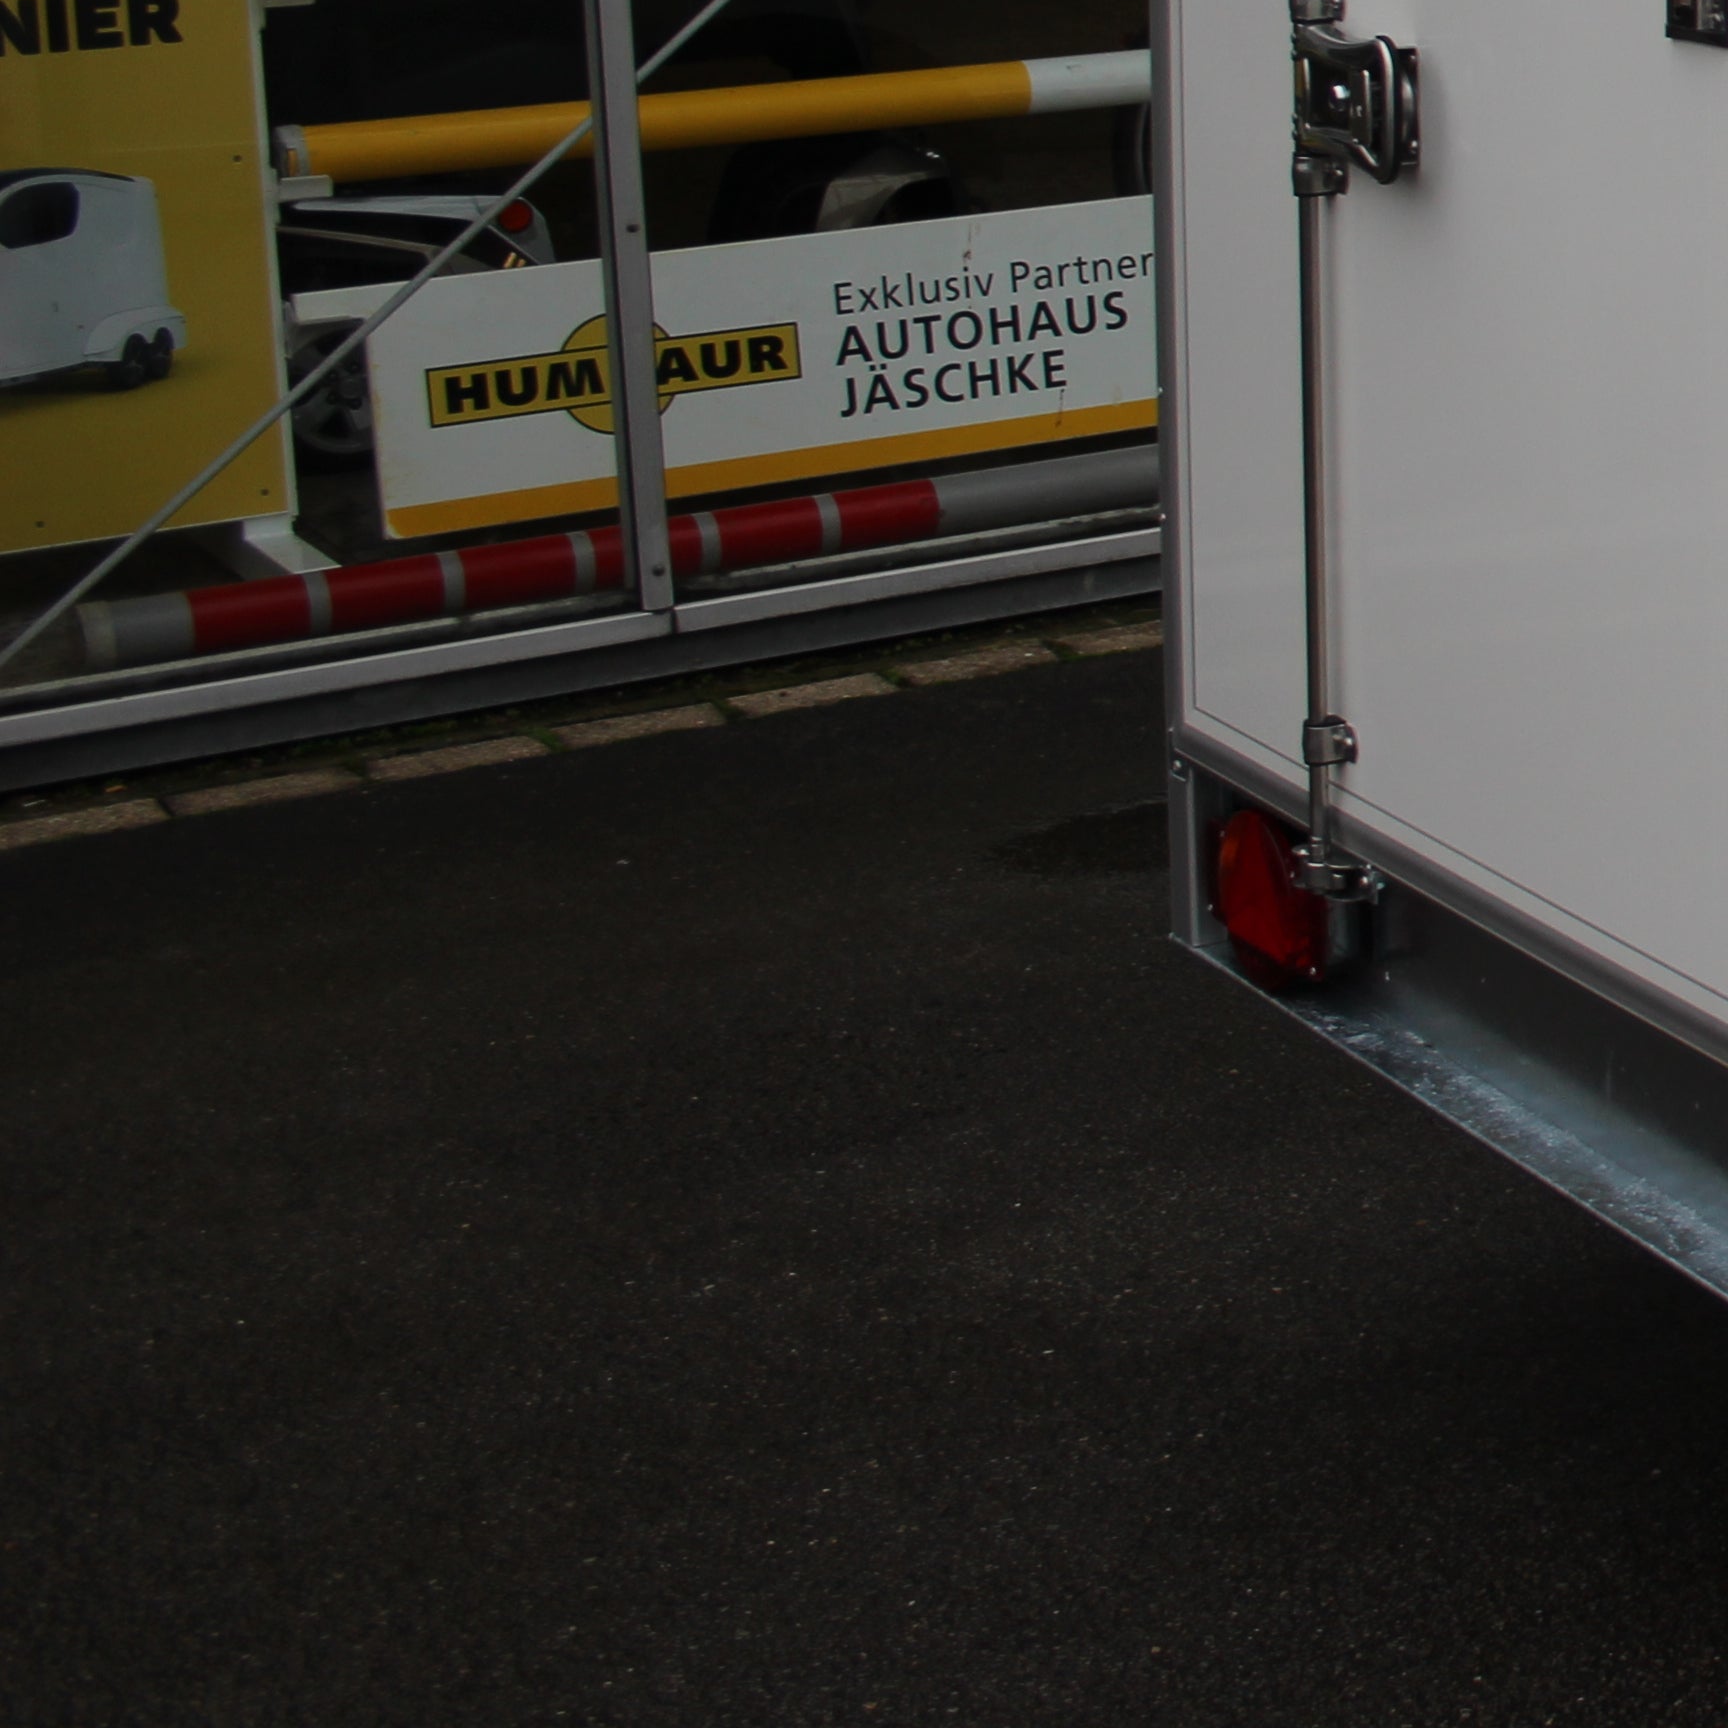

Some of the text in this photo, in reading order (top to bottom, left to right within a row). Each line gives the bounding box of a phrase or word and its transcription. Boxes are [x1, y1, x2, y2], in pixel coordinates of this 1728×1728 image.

[834, 252, 1154, 315] Exklusiv Partner
[836, 291, 1129, 365] AUTOHAUS
[443, 334, 789, 415] HUMAUR
[840, 349, 1068, 417] JÄSCHKE
